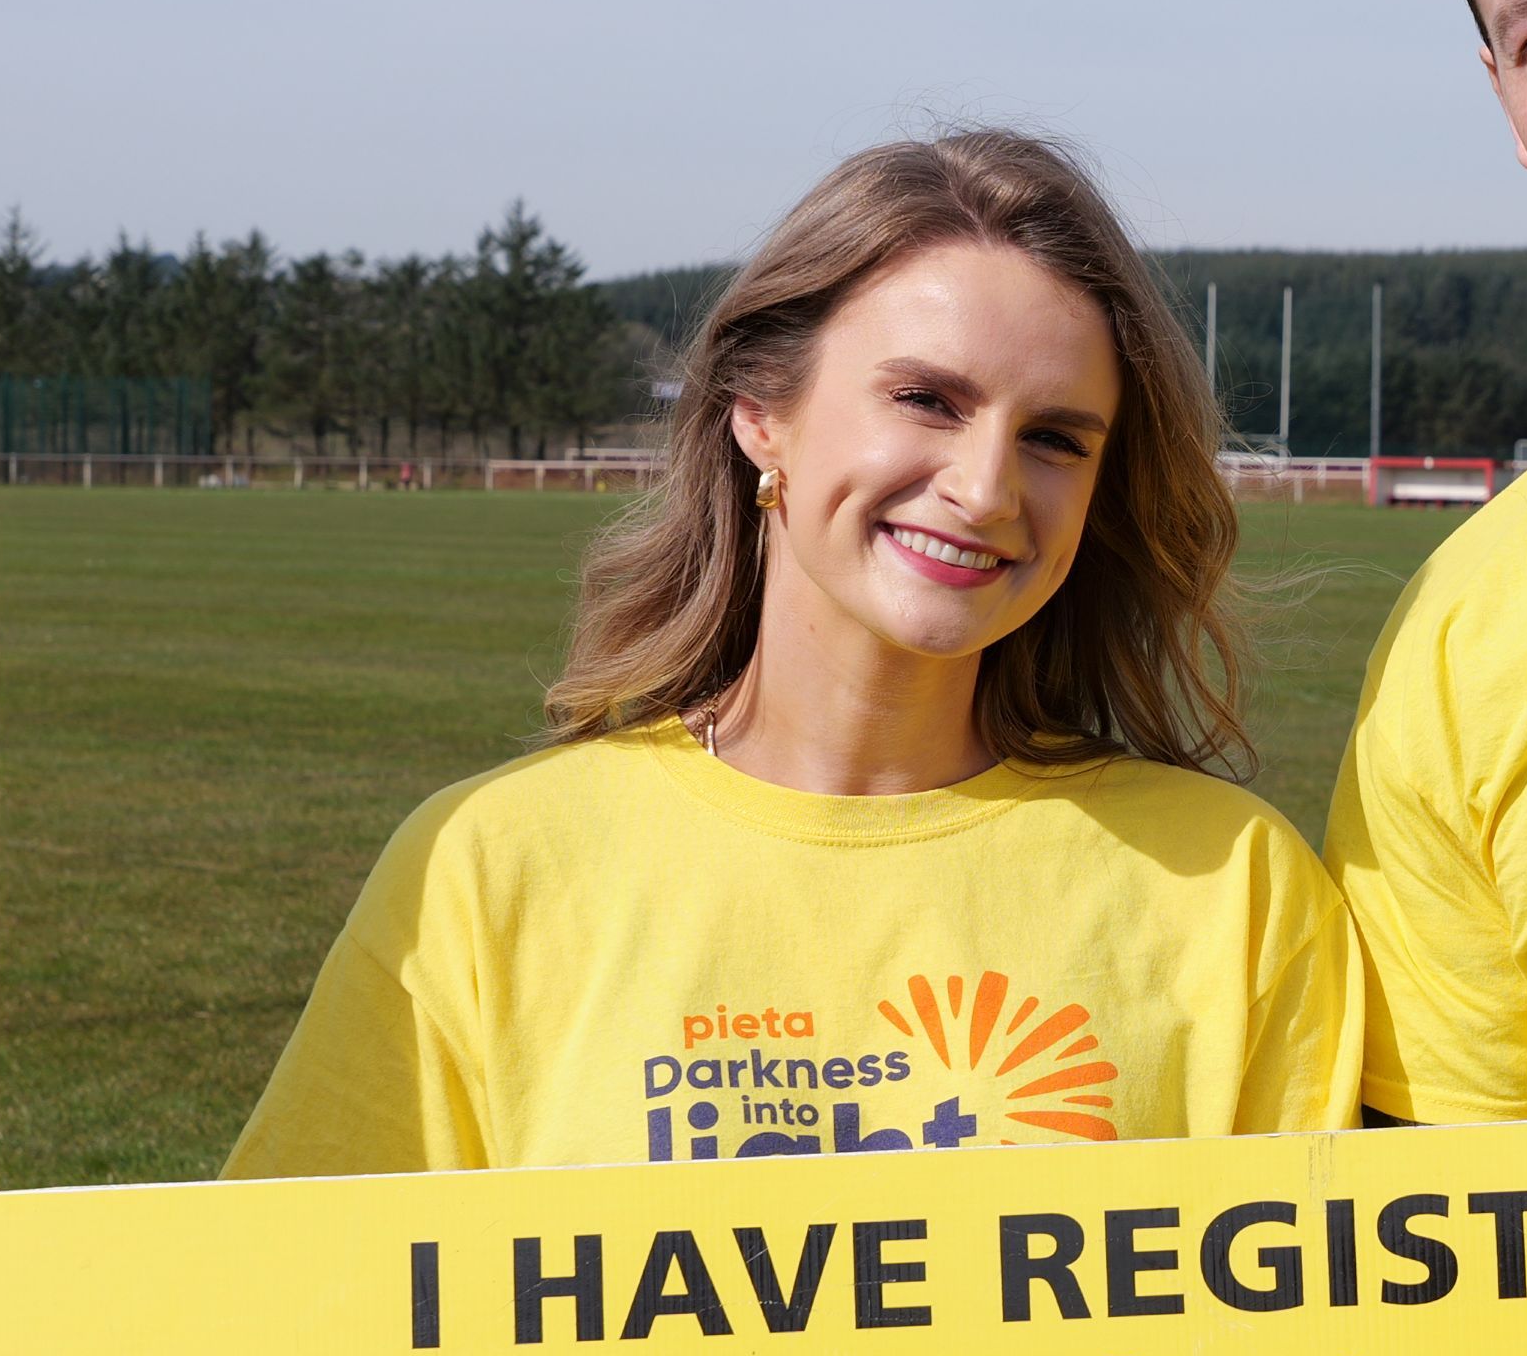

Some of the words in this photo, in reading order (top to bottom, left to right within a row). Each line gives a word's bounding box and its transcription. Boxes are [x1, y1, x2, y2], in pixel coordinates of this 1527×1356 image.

[683, 1004, 814, 1049] pieta
[644, 1049, 911, 1099] Darkness
[741, 1095, 819, 1126] into
[411, 1241, 440, 1349] I
[513, 1218, 932, 1345] HAVE
